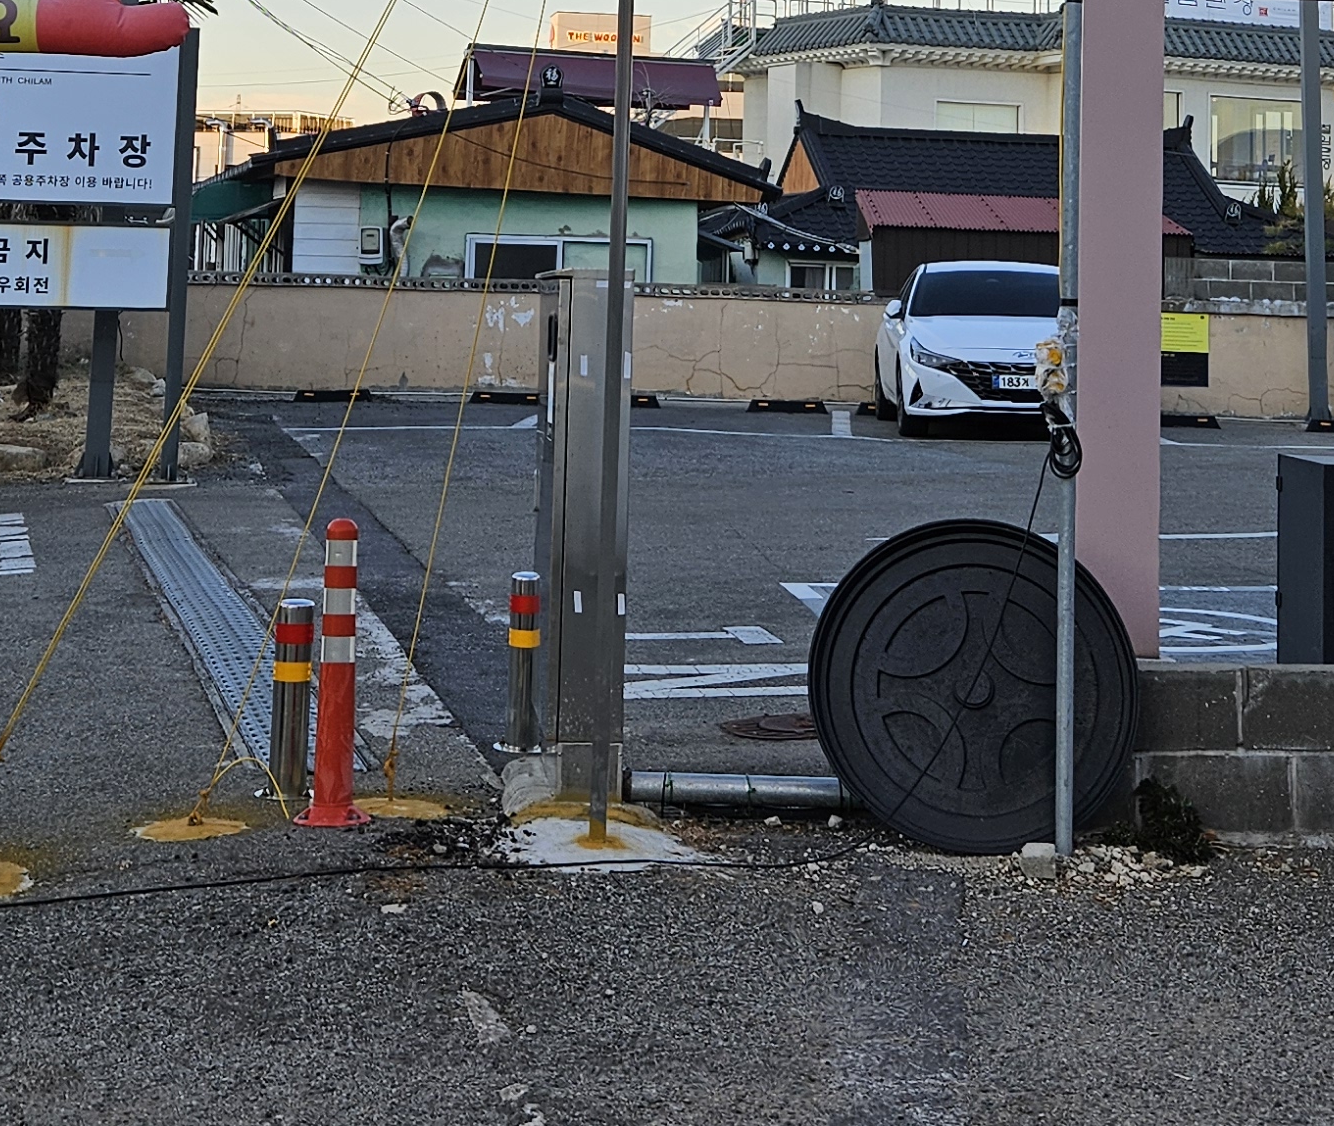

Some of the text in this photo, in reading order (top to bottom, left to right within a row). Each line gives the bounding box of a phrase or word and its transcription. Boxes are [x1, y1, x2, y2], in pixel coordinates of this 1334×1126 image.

[567, 31, 588, 41] THE
[17, 77, 53, 86] CHILAM
[11, 174, 70, 188] 공용주차장
[74, 176, 98, 189] 이용
[101, 177, 153, 190] 바랍니다!
